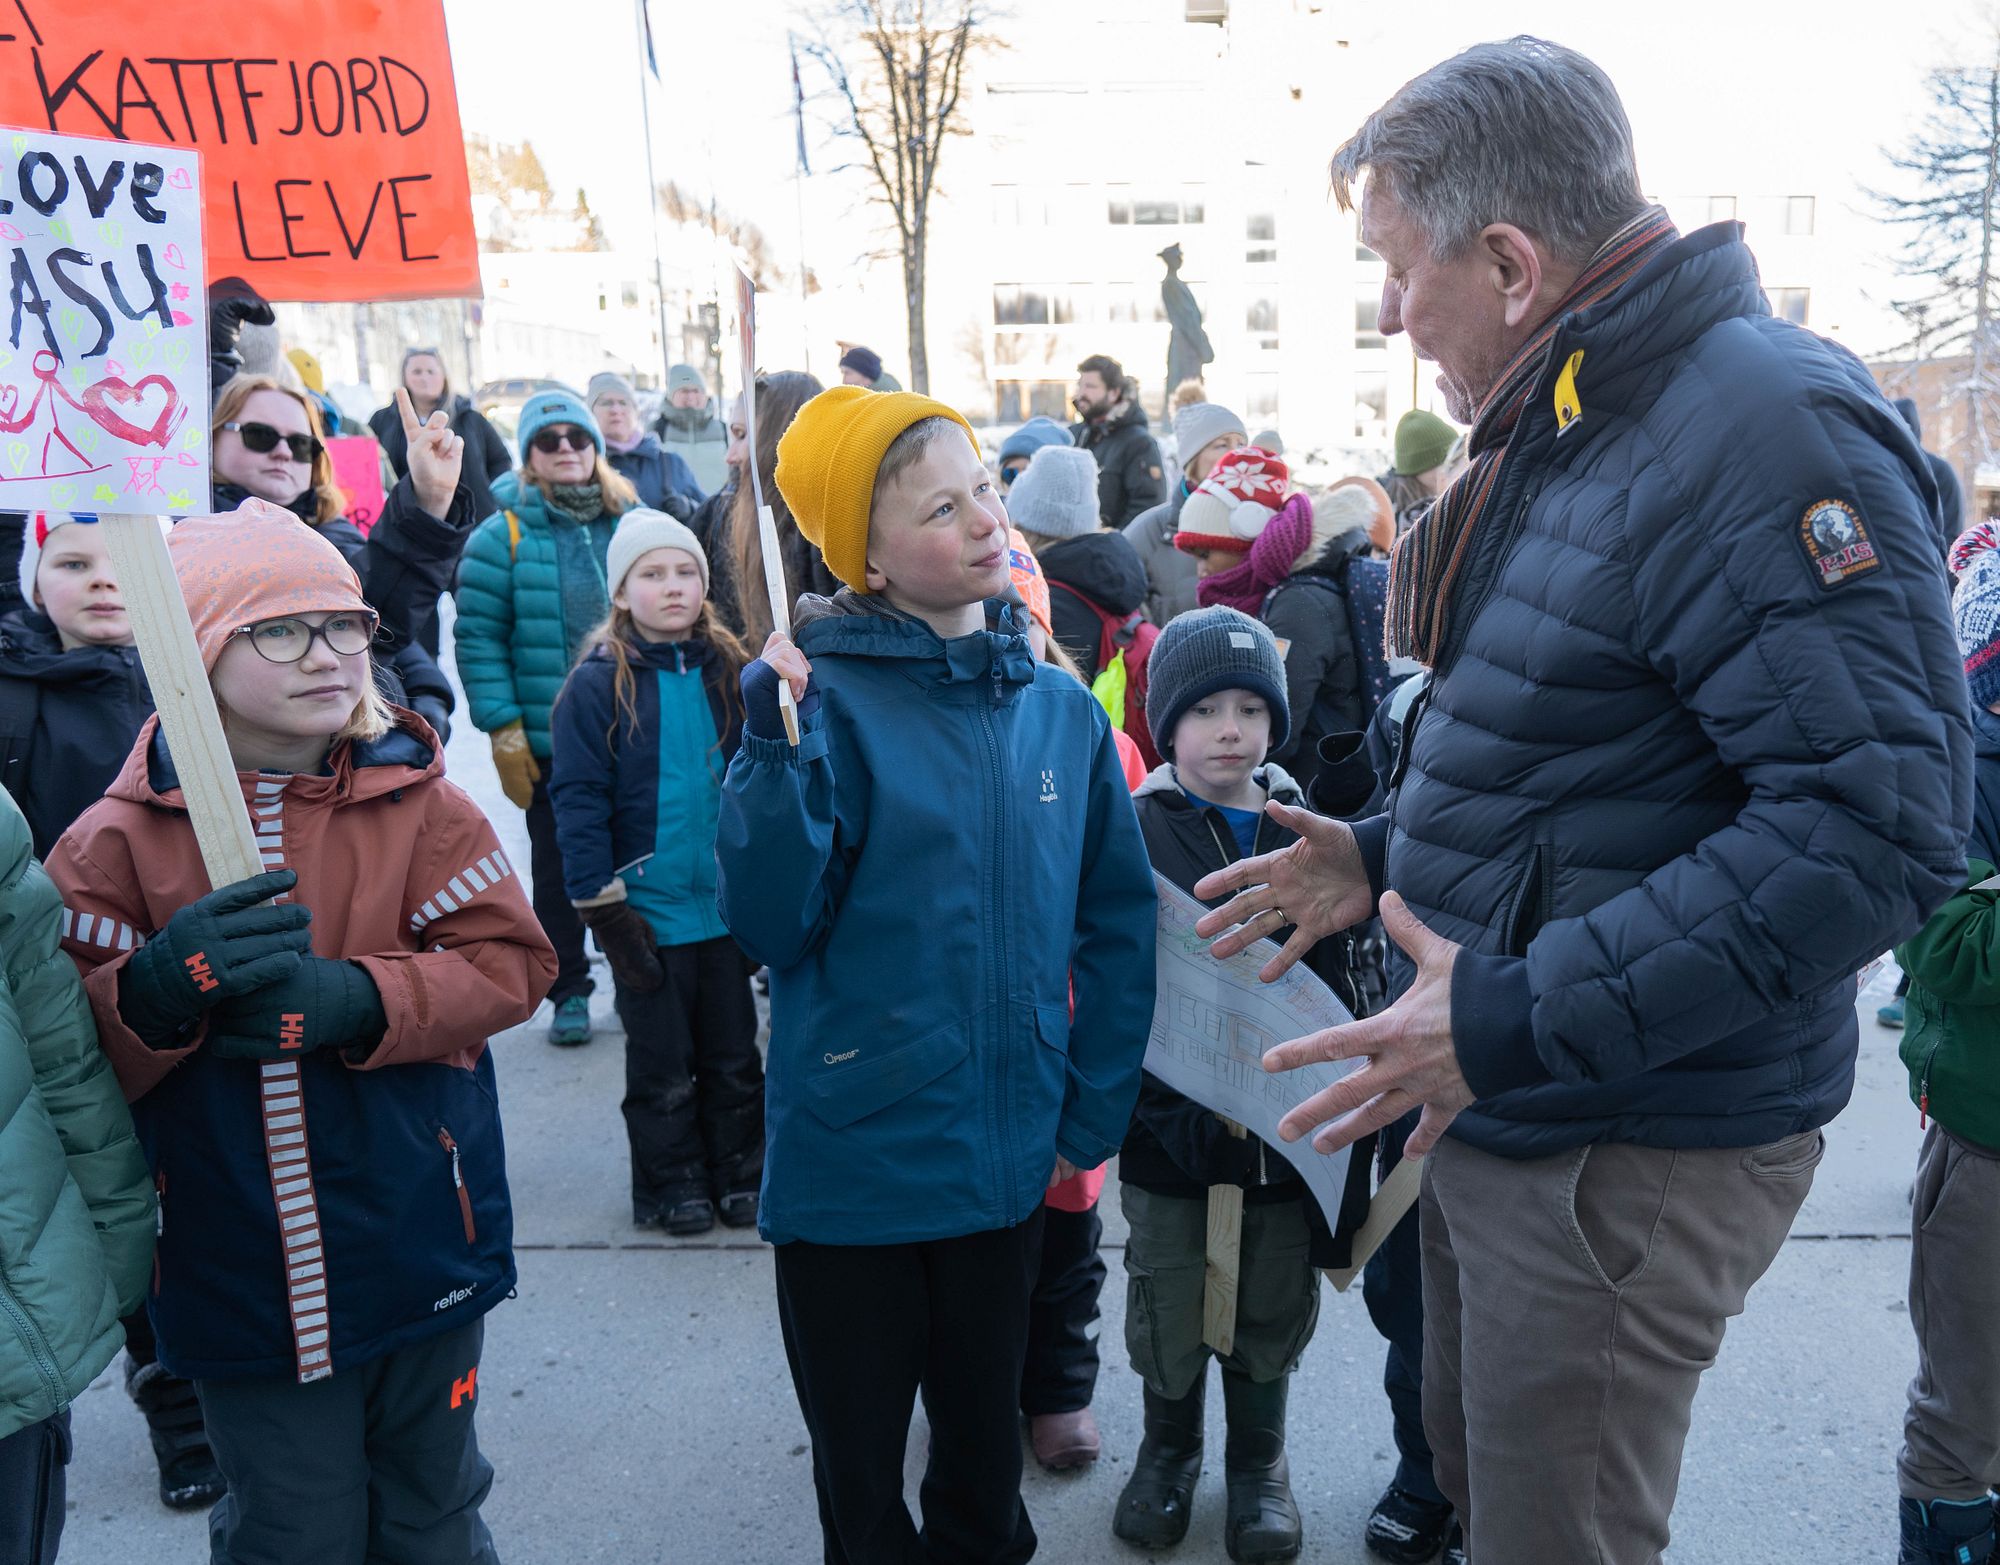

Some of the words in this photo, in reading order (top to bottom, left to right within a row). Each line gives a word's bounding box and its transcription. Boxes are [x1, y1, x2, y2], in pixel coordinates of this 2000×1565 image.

[30, 46, 430, 145] KATTFJORD
[0, 151, 167, 224] OVe
[233, 174, 440, 262] LEVE
